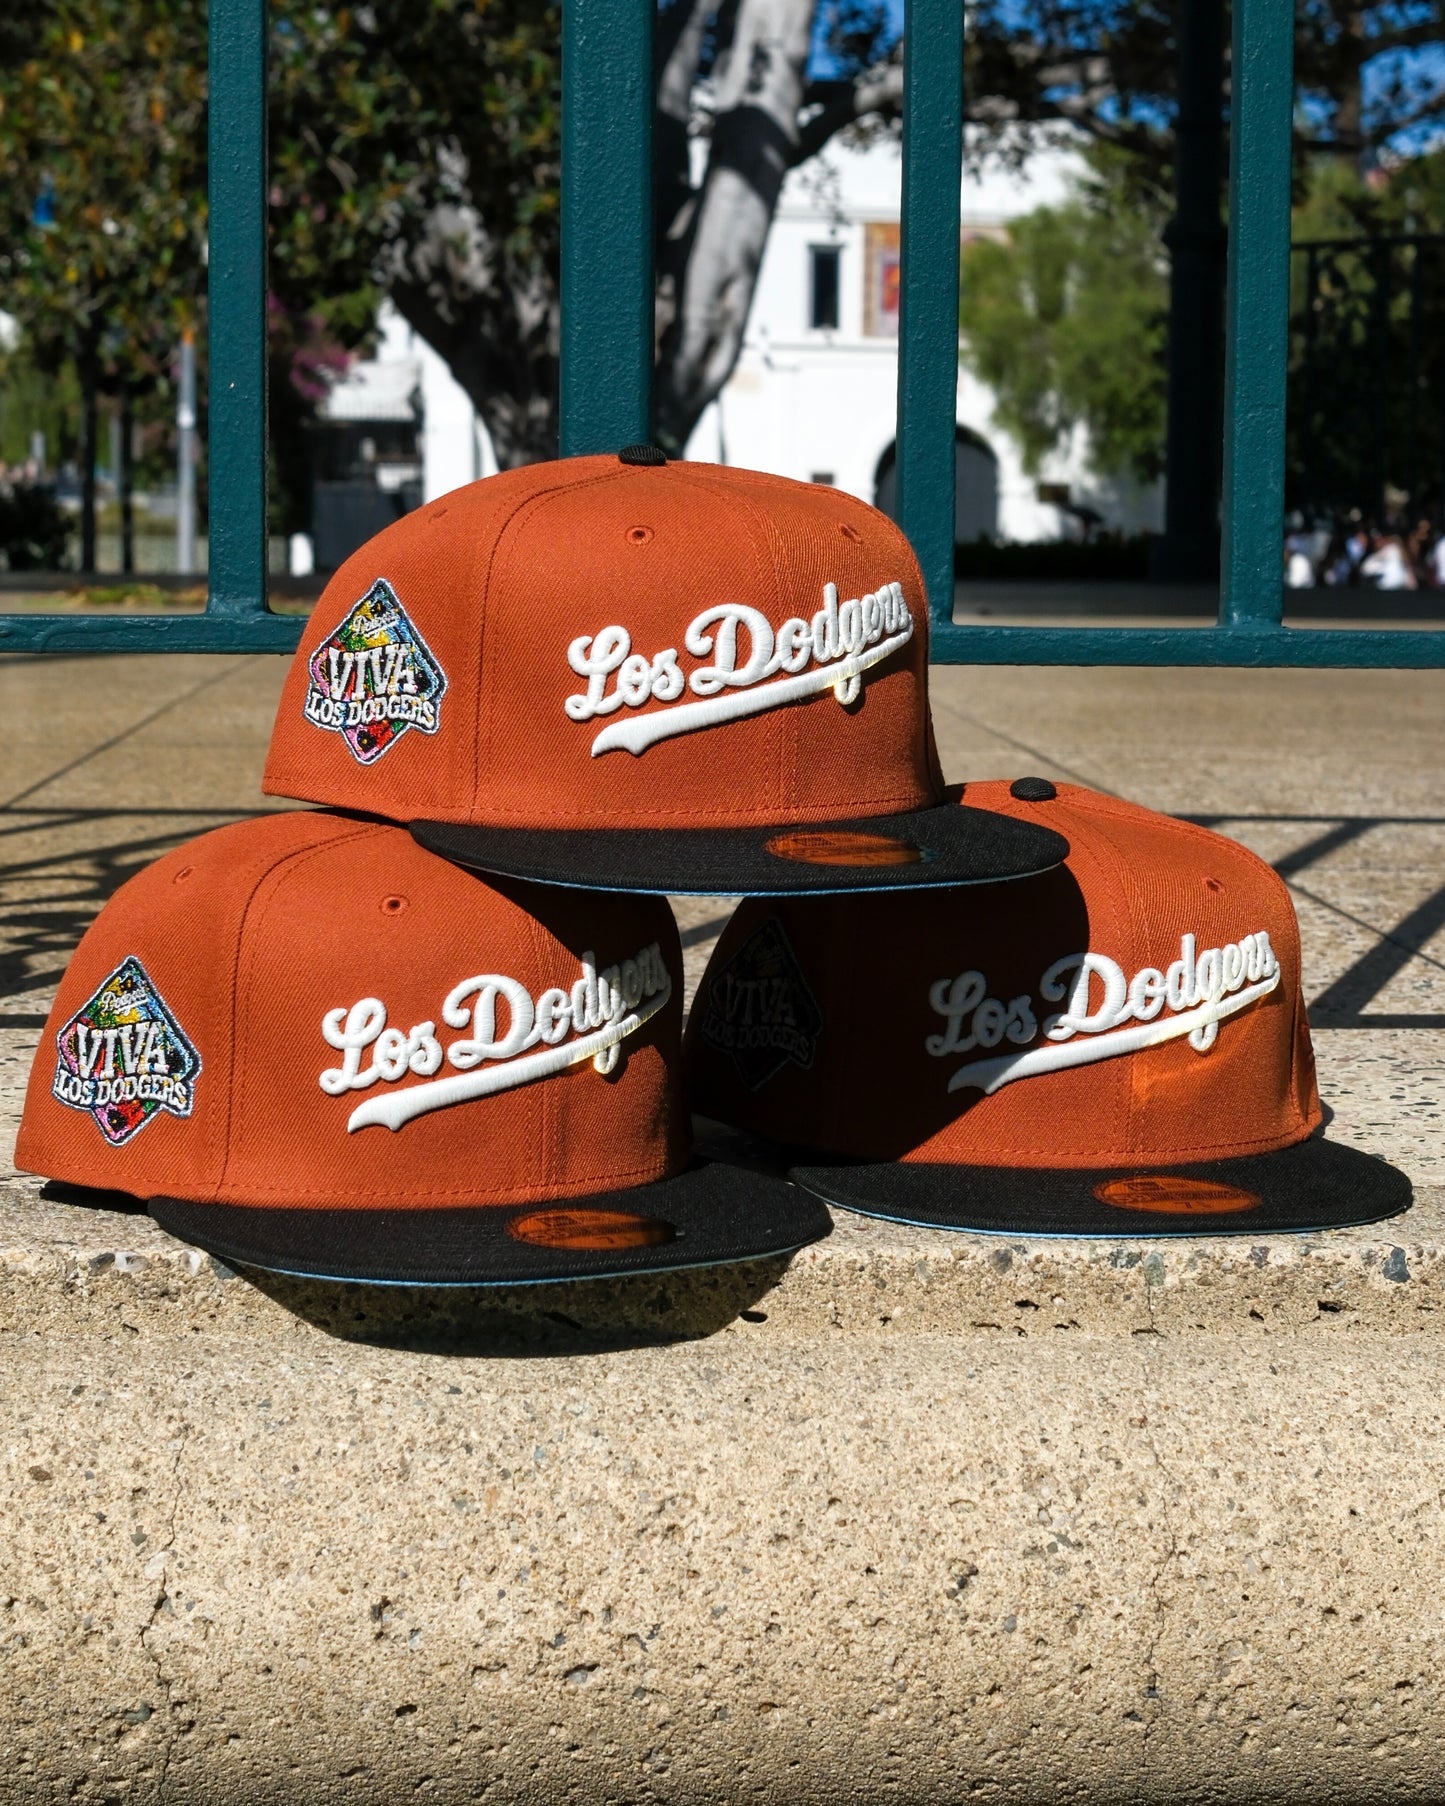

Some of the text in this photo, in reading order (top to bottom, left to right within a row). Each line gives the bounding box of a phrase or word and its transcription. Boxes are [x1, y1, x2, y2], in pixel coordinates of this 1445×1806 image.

[328, 642, 418, 700] VIVA
[565, 582, 912, 720] Los Dodgers
[306, 691, 435, 729] LOS DODGERS
[319, 942, 671, 1095] Los Dodgers
[925, 931, 1280, 1057] Los Dodgers
[76, 1021, 170, 1079] VIVA
[54, 1070, 187, 1110] LOS DODGERS
